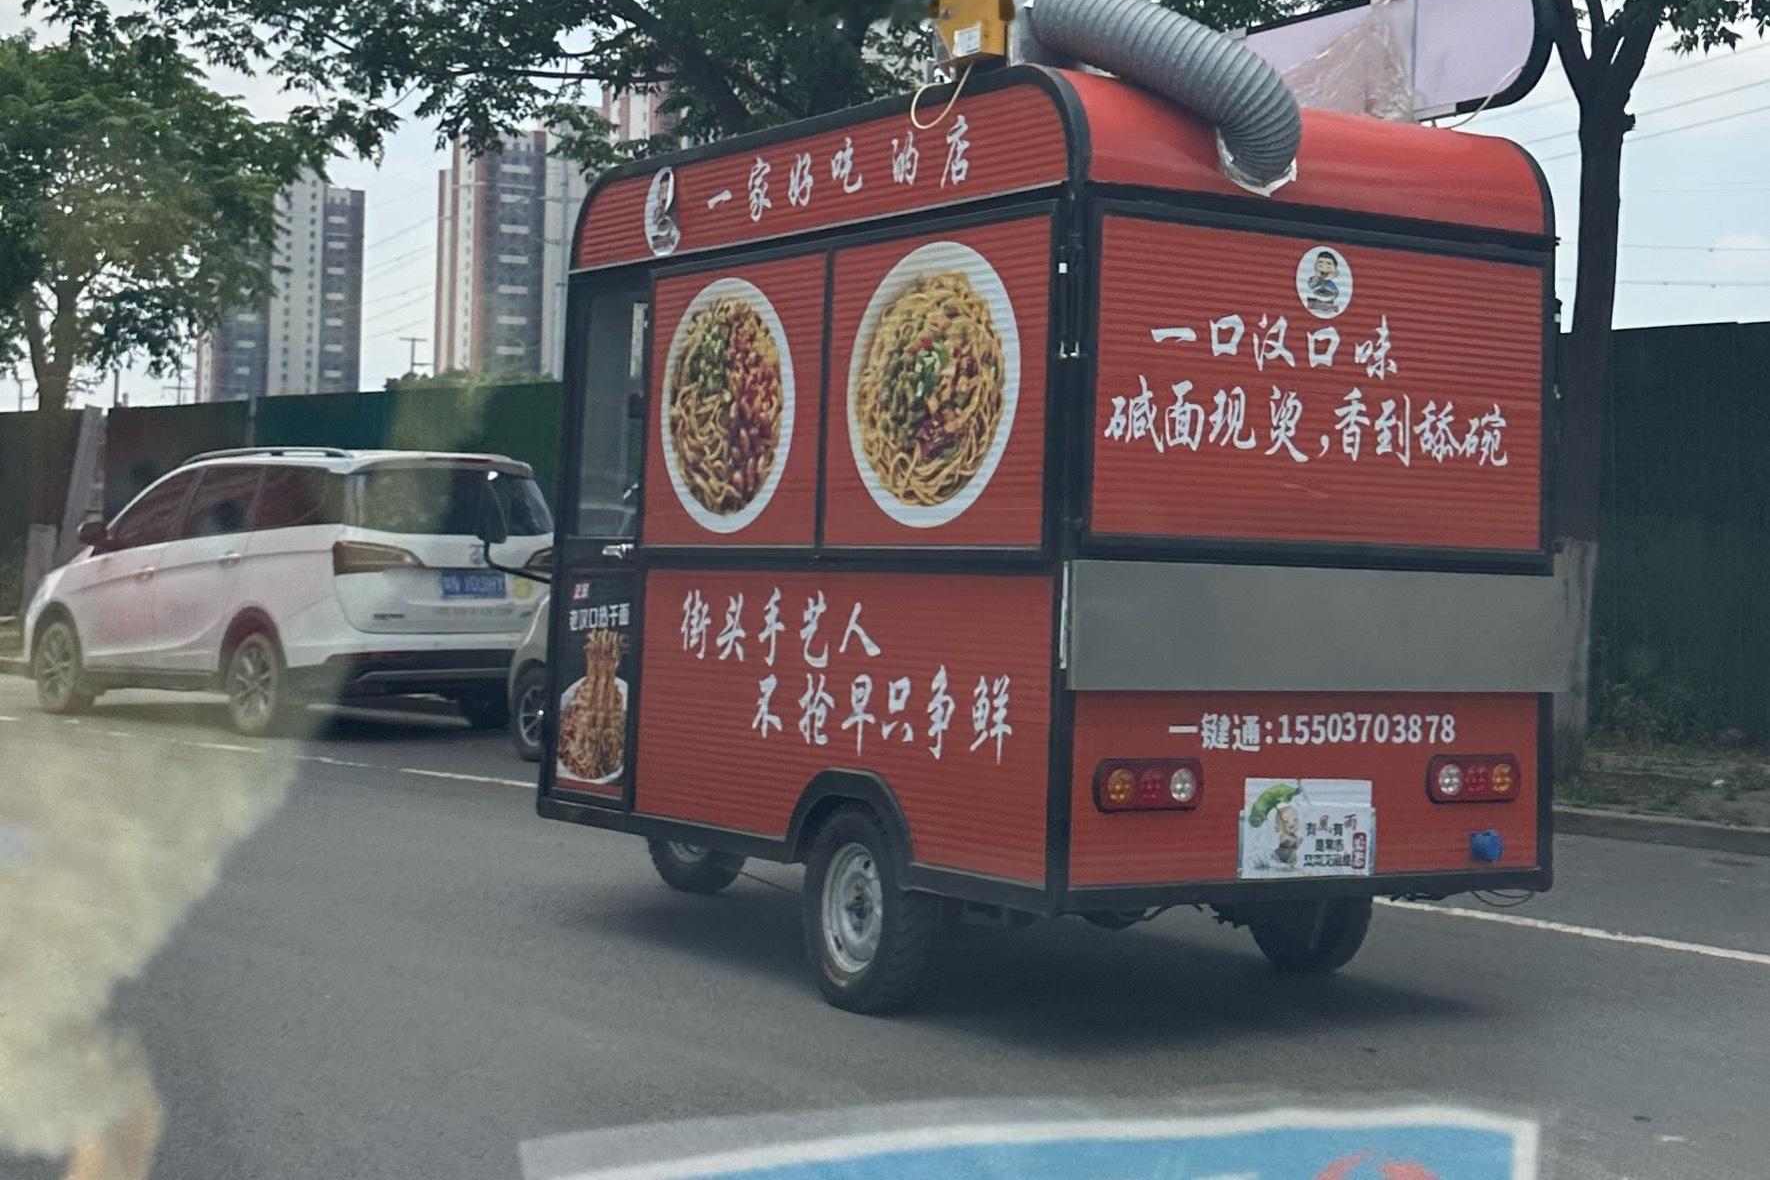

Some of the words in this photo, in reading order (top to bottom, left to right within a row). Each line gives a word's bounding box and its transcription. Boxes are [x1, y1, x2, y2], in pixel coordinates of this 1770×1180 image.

[707, 115, 970, 222] 一家好吃的店
[1151, 314, 1397, 380] 一口汉口味
[681, 587, 881, 668] 街头手艺人
[752, 664, 1012, 765] 不抢早只争鲜
[1169, 712, 1456, 751] 一键通:15503703878
